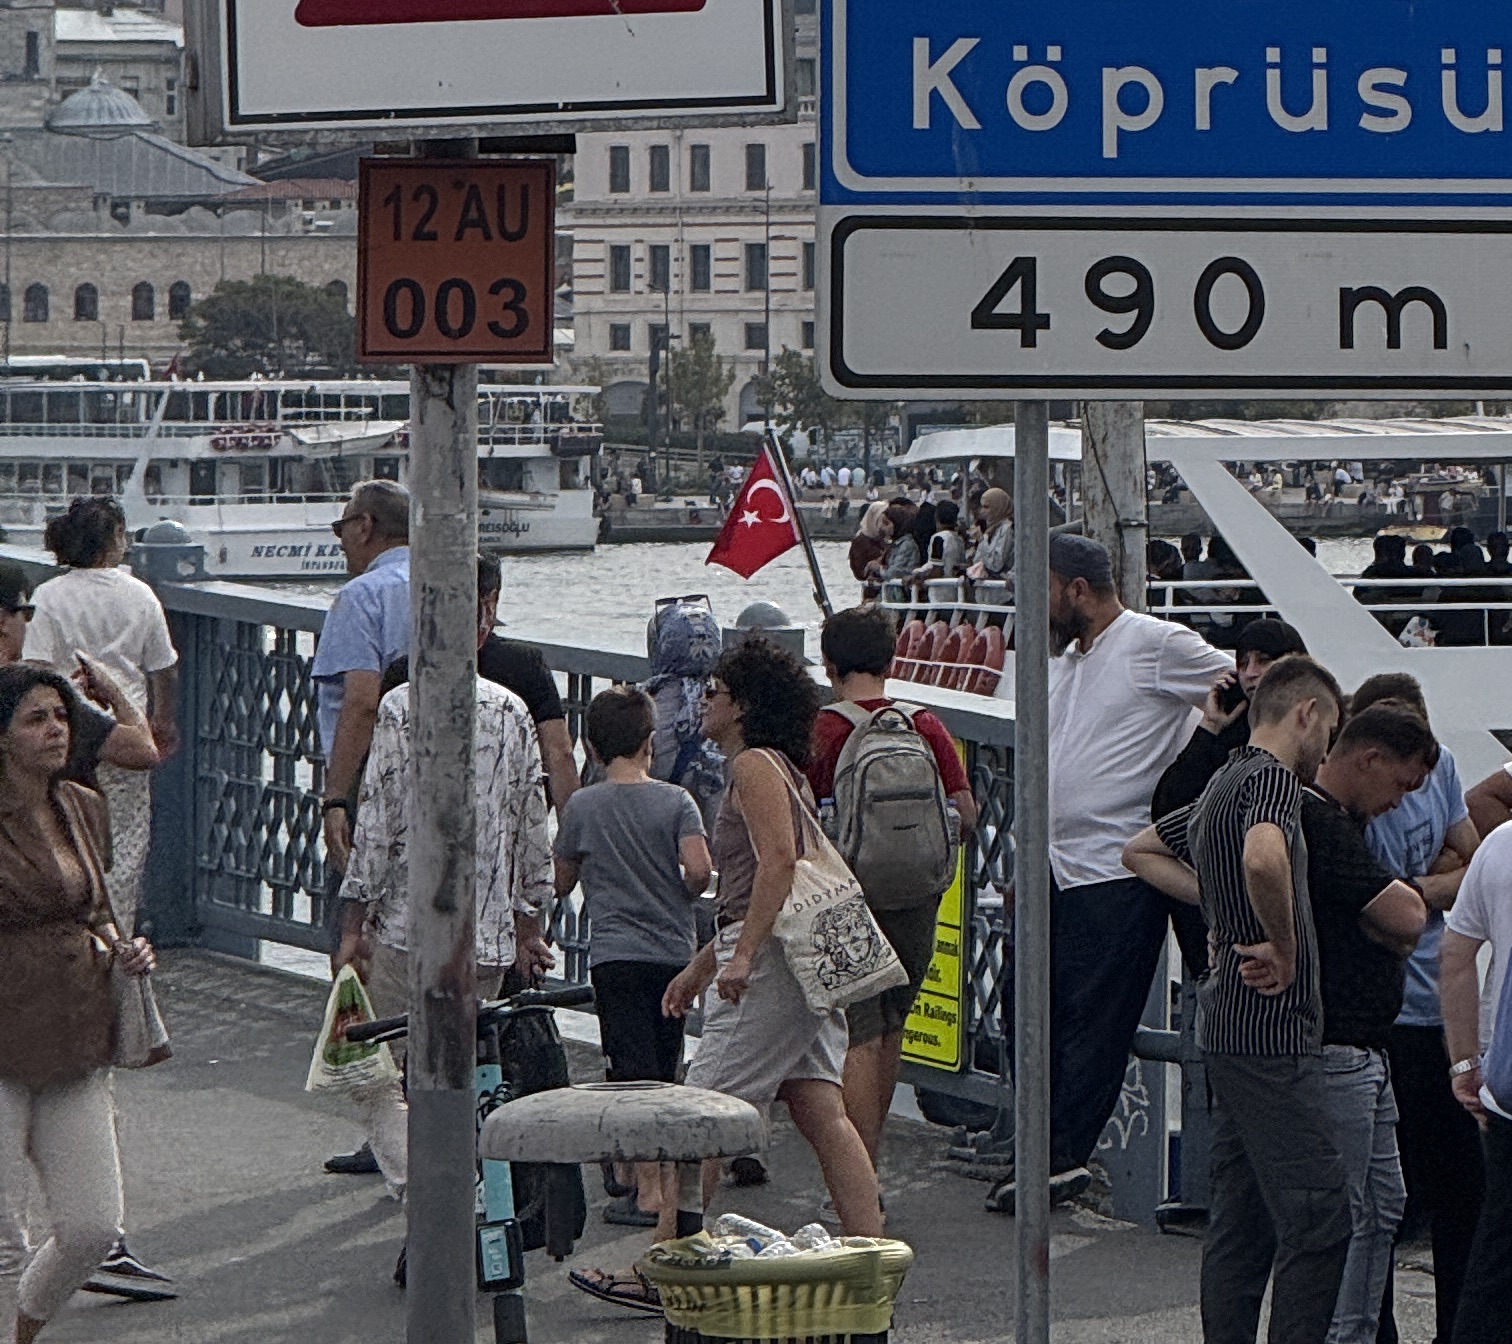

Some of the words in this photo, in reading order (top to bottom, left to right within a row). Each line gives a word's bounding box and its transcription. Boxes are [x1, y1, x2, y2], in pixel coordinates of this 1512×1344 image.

[912, 36, 1505, 159] Köprüsü
[383, 278, 530, 339] 003
[971, 256, 1266, 351] 490
[1338, 285, 1449, 351] m
[924, 1002, 957, 1027] Railings
